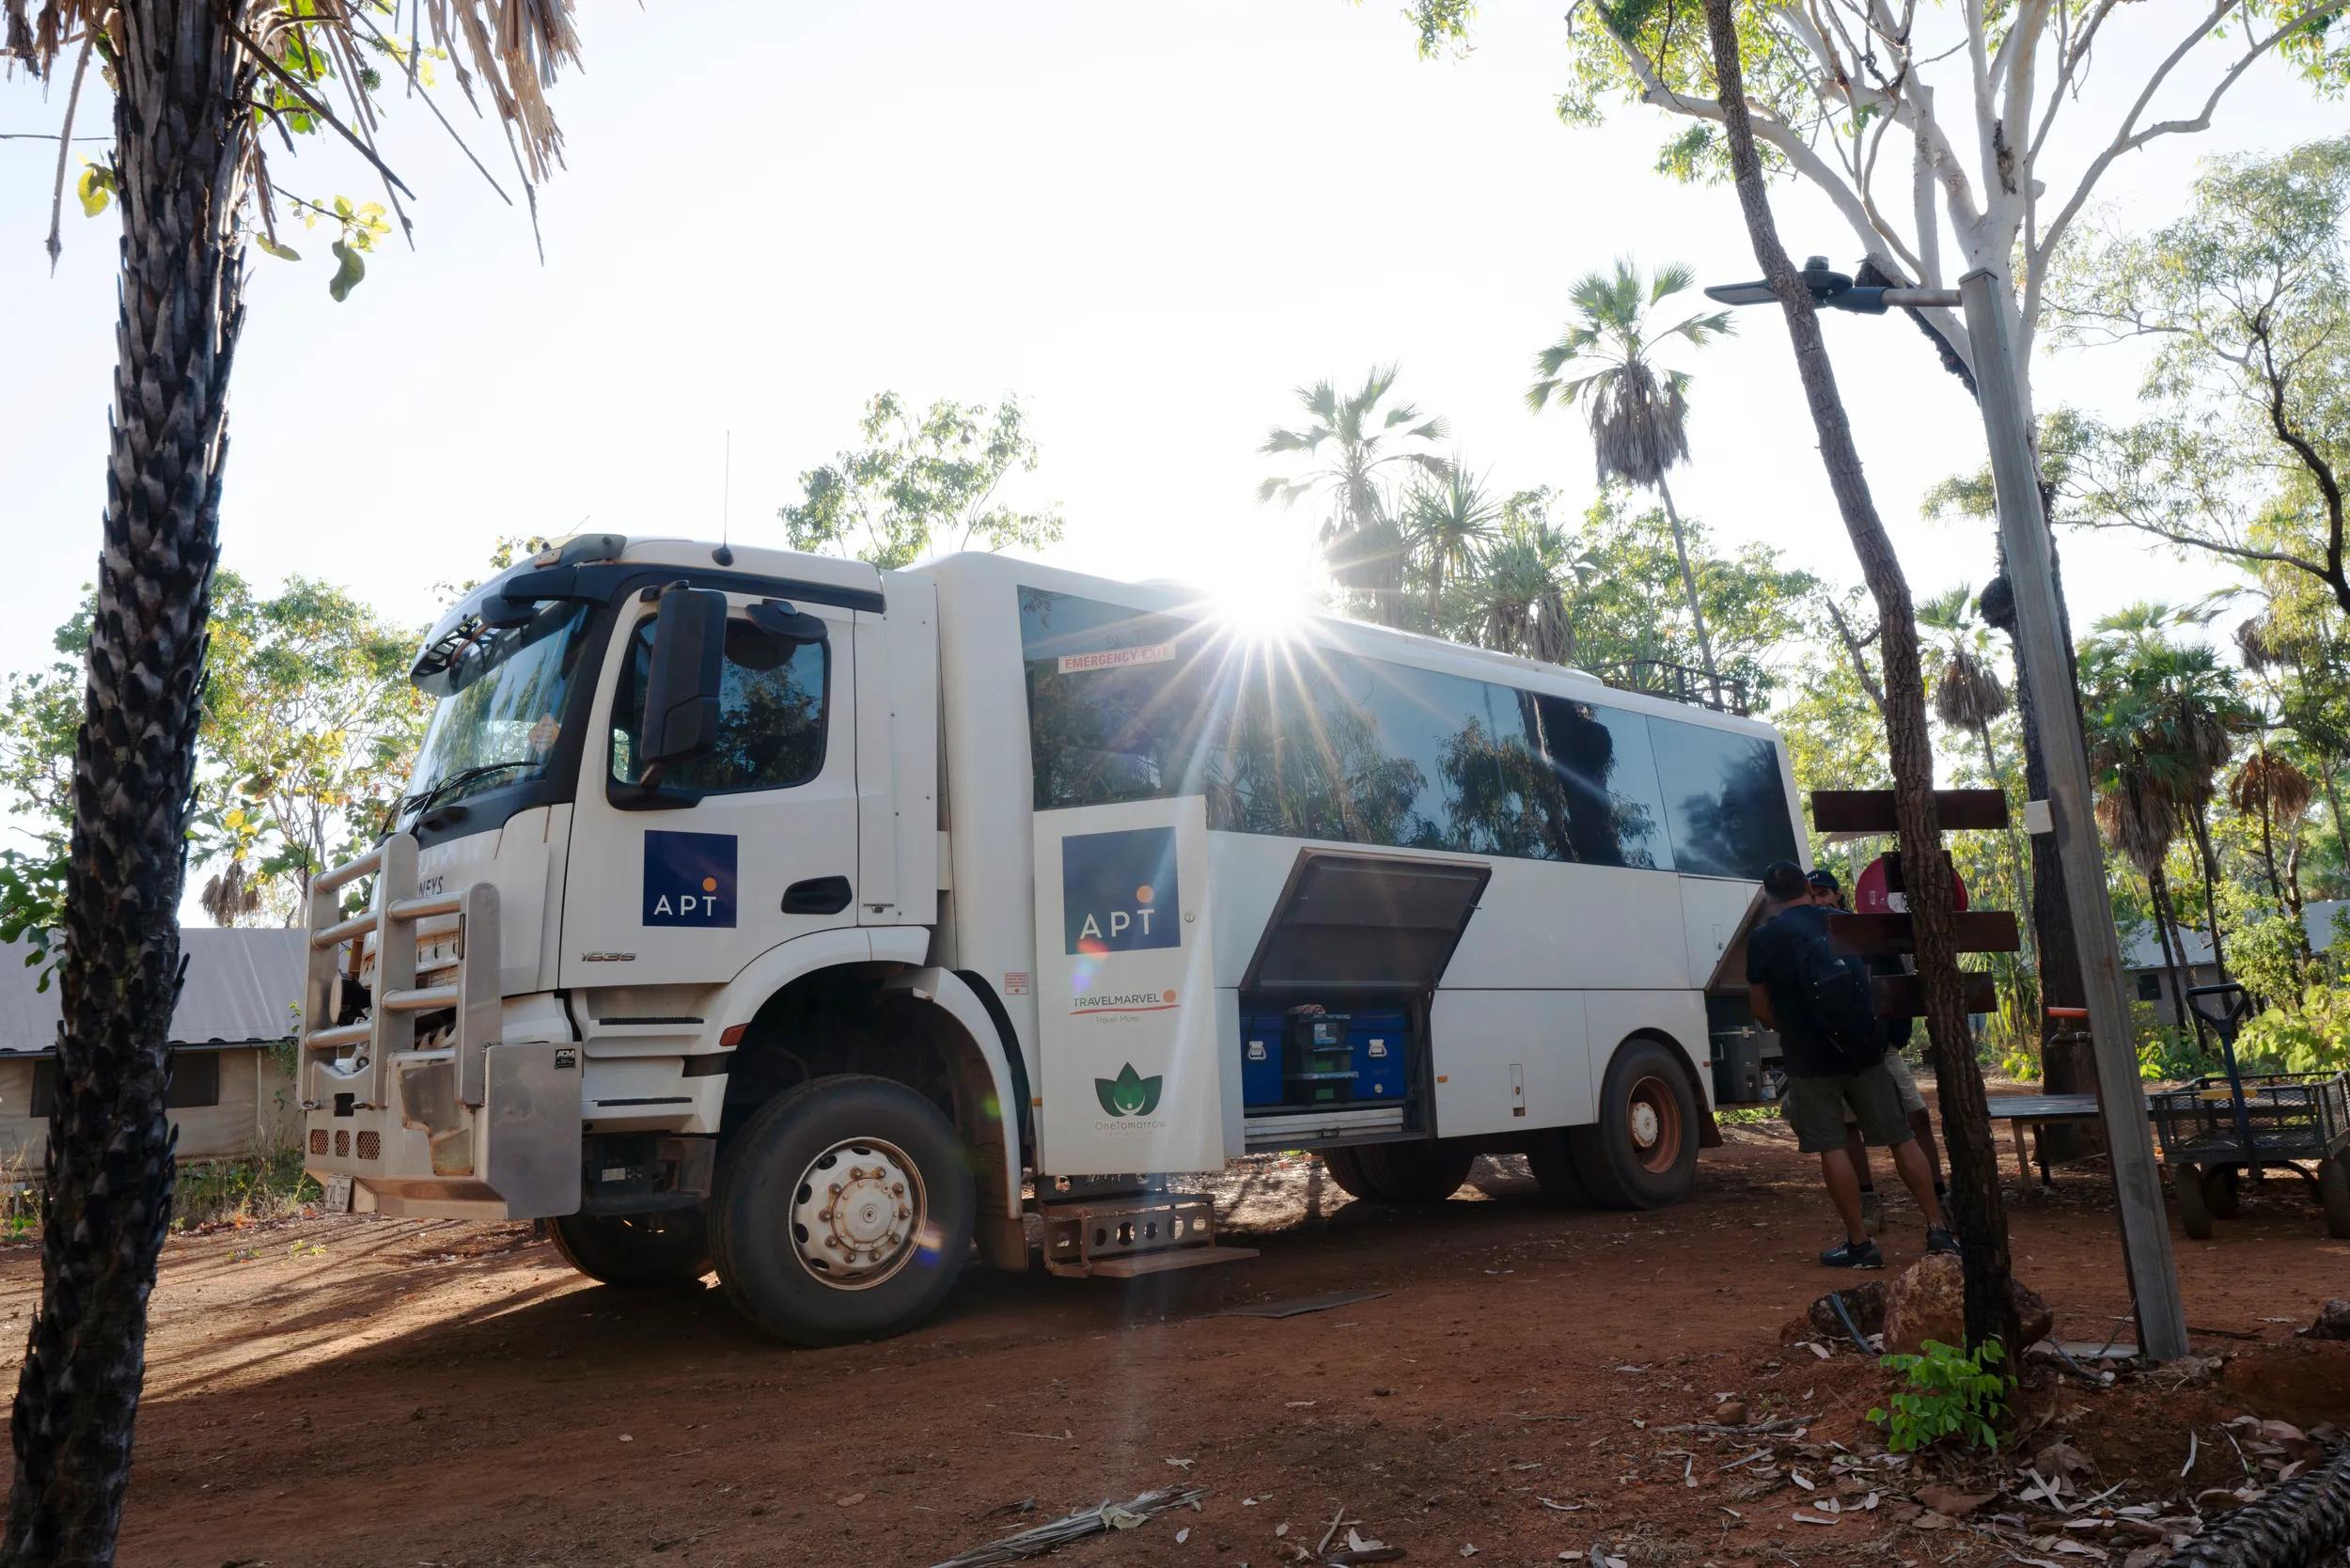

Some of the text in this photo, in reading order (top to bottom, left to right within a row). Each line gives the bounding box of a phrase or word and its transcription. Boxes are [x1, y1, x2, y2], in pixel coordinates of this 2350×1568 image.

[1064, 646, 1167, 670] EMERGENCY EXIT
[653, 894, 717, 917] APT
[1079, 908, 1155, 940] APT
[1073, 993, 1161, 1008] TRAVELMARVEL
[1120, 1015, 1140, 1024] More
[1094, 1121, 1167, 1131] OneTomorrow
